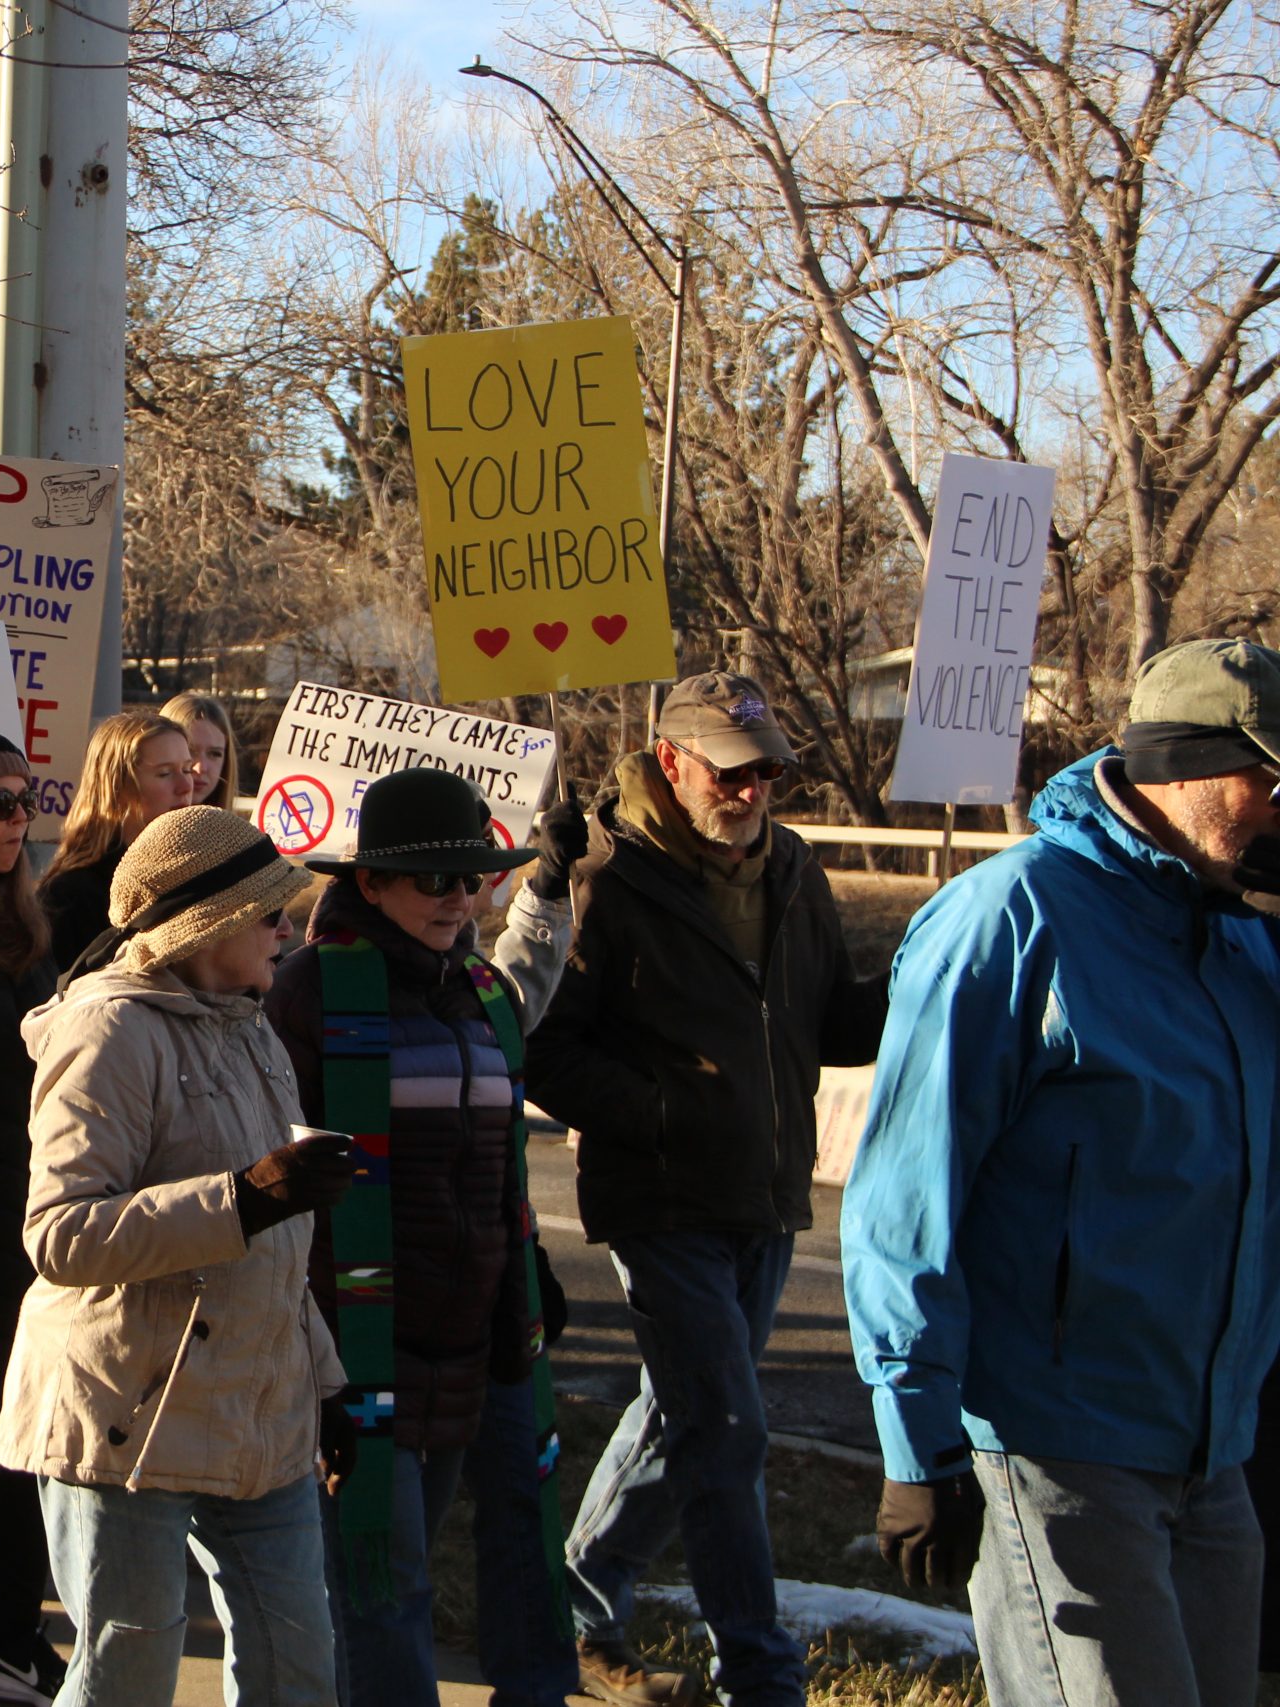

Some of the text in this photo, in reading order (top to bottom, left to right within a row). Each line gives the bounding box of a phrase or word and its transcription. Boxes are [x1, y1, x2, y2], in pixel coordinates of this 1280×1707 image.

[425, 352, 616, 432] LOVE
[435, 442, 590, 522] YOUR
[435, 518, 653, 602] NEIGHBOR
[951, 492, 1035, 569] END
[944, 574, 1023, 655] THE
[293, 684, 551, 759] FIRST, THEY CAME for
[916, 663, 1031, 738] VIOLENCE
[286, 724, 336, 762] THE
